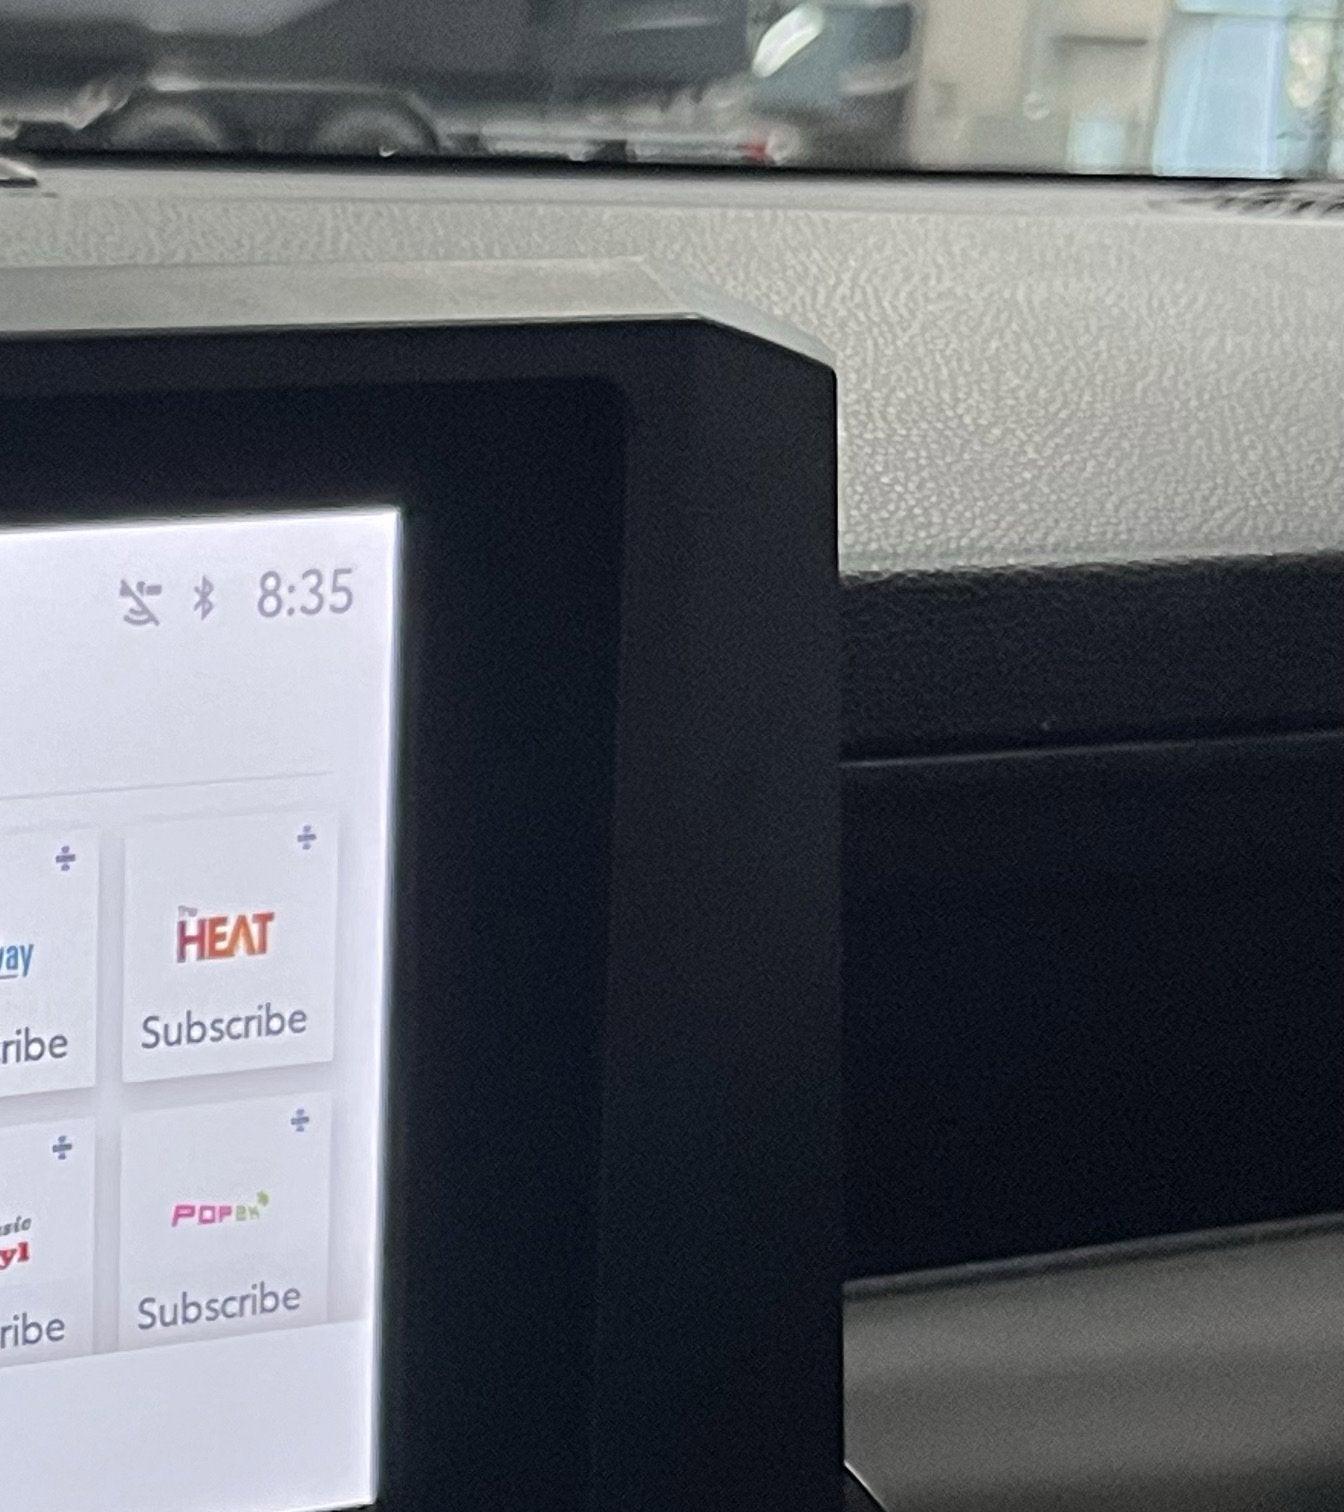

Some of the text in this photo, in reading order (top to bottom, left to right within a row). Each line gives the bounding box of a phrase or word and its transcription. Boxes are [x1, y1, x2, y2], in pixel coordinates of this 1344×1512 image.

[257, 567, 355, 618] 8:35
[177, 911, 275, 963] HEAT
[141, 1003, 309, 1051] Subscribe
[137, 1282, 302, 1331] Subscribe
